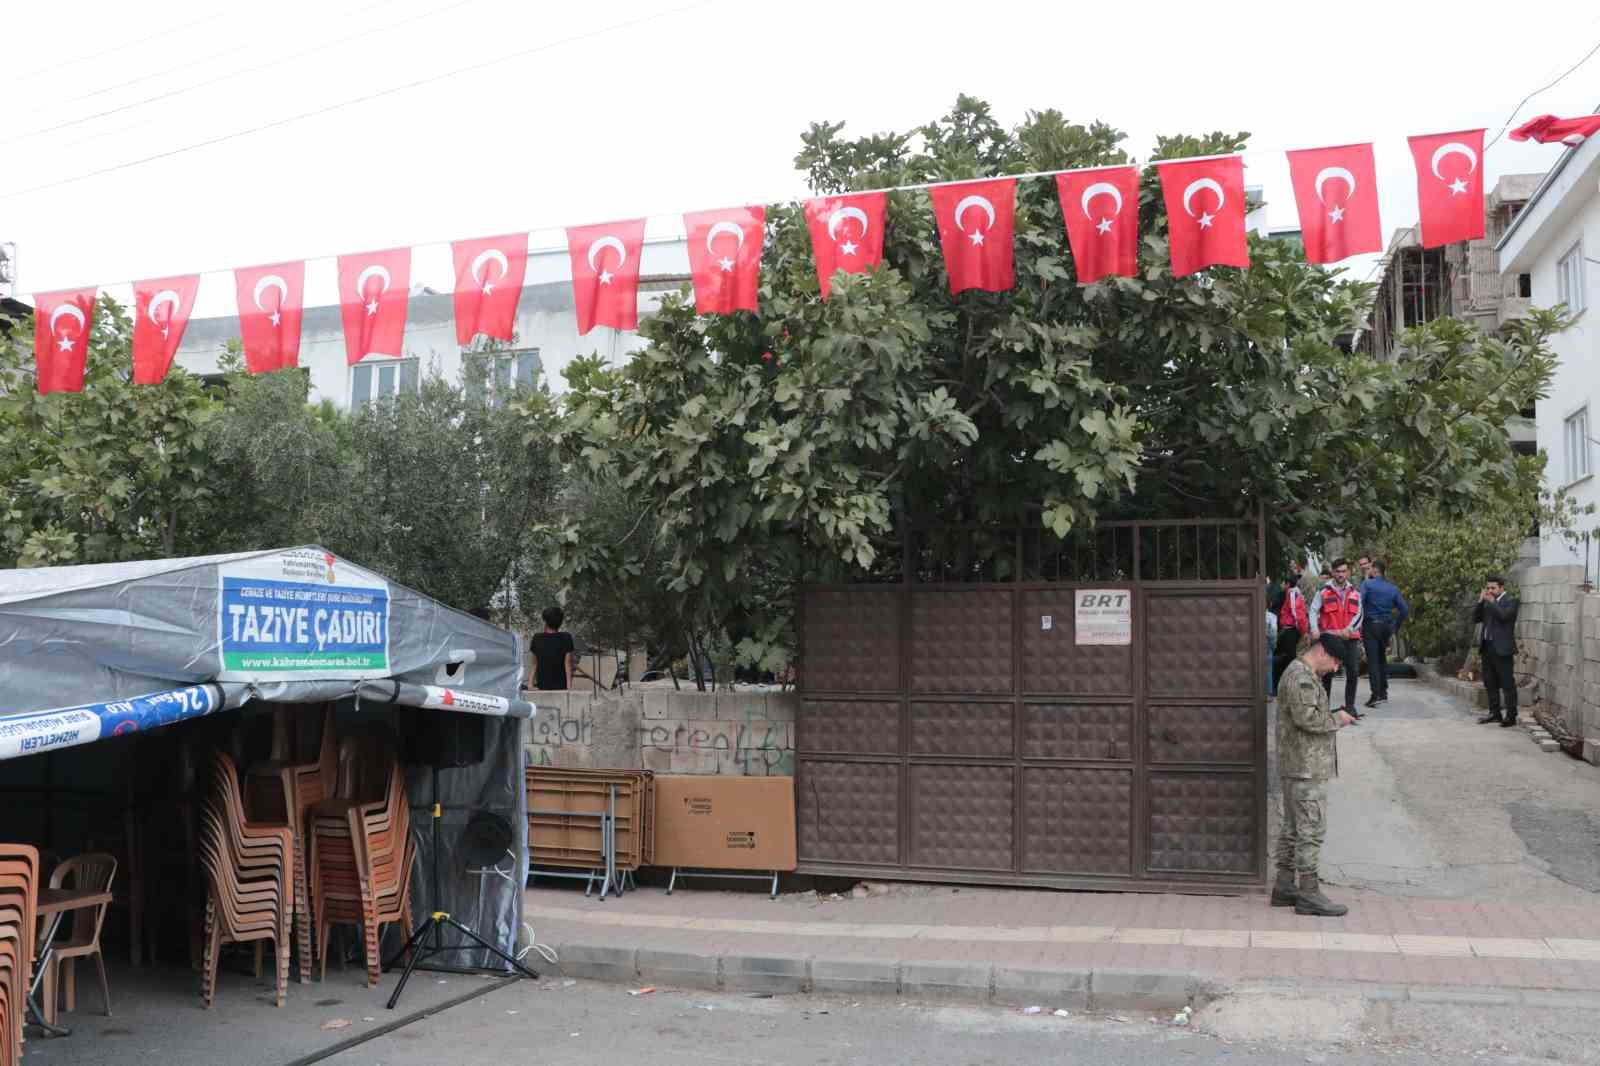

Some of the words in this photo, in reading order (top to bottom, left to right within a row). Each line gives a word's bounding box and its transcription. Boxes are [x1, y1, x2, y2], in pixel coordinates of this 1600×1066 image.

[1080, 594, 1127, 607] BRT
[228, 603, 309, 644] TAZİYE
[314, 608, 382, 651] ÇADIRI
[105, 701, 134, 714] ALO
